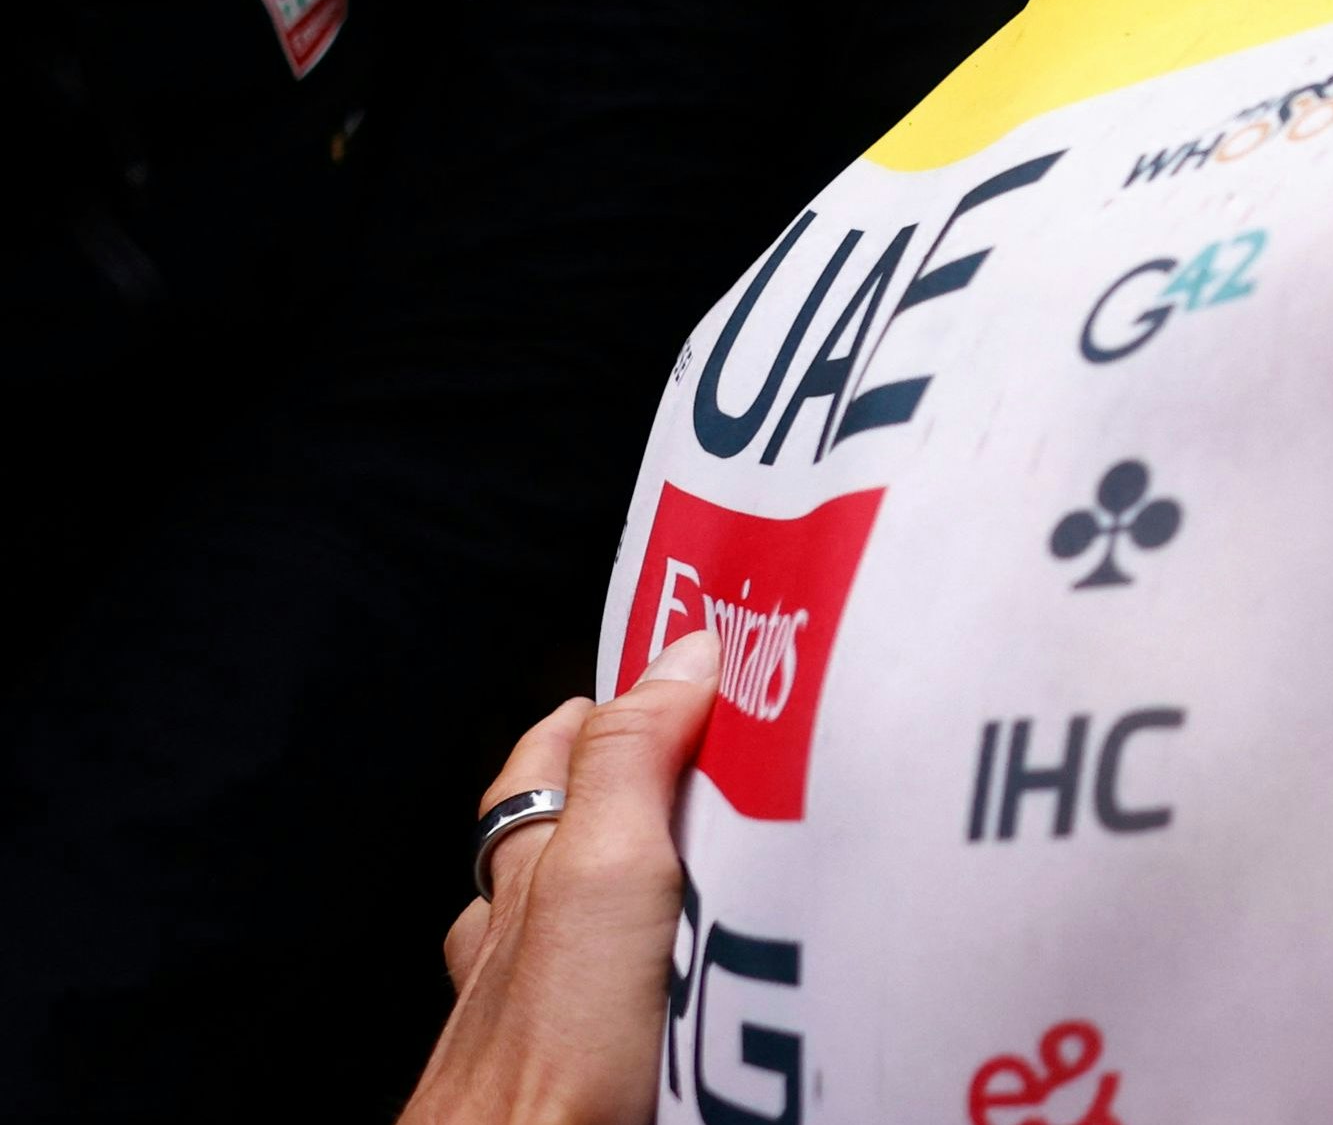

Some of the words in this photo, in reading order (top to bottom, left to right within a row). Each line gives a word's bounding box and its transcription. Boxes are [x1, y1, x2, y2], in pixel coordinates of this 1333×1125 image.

[692, 147, 1070, 466] UAE
[1077, 228, 1269, 364] G42
[967, 707, 1187, 844] IHC
